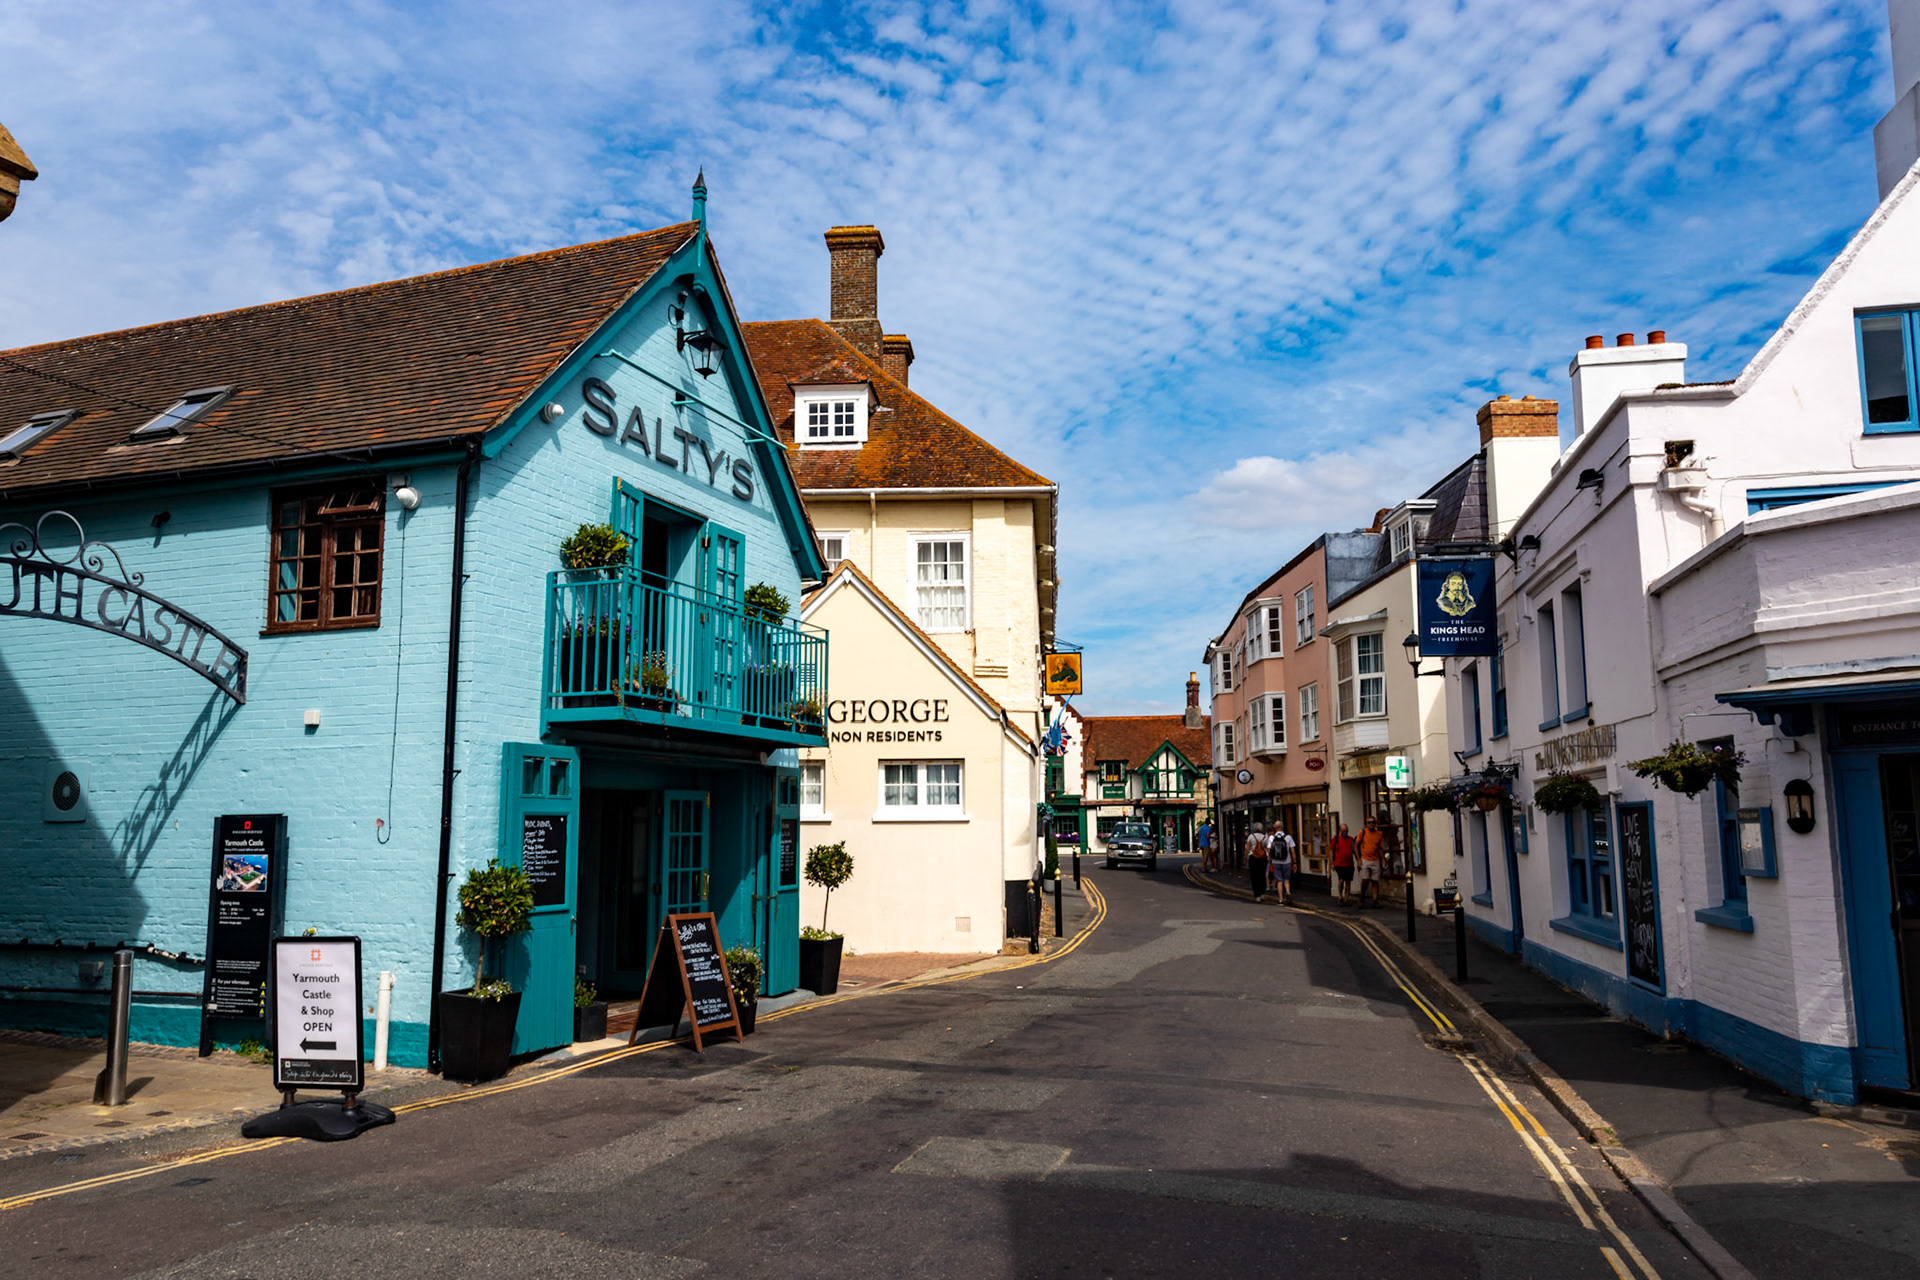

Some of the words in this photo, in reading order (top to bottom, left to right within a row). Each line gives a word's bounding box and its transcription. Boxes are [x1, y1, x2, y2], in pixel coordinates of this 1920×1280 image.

[582, 377, 755, 501] SALTY'S
[97, 586, 242, 681] CASTLE
[1430, 626, 1458, 635] KINGS
[1460, 626, 1486, 634] HEAD
[828, 698, 949, 724] GEORGE
[1853, 720, 1908, 733] ENTRANCE
[831, 731, 862, 743] NON
[866, 730, 943, 743] RESIDENTS
[292, 973, 340, 983] Yarmouth
[302, 989, 332, 999] Castle
[301, 1006, 308, 1016] &
[310, 1006, 335, 1018] Shop
[303, 1022, 333, 1032] OPEN
